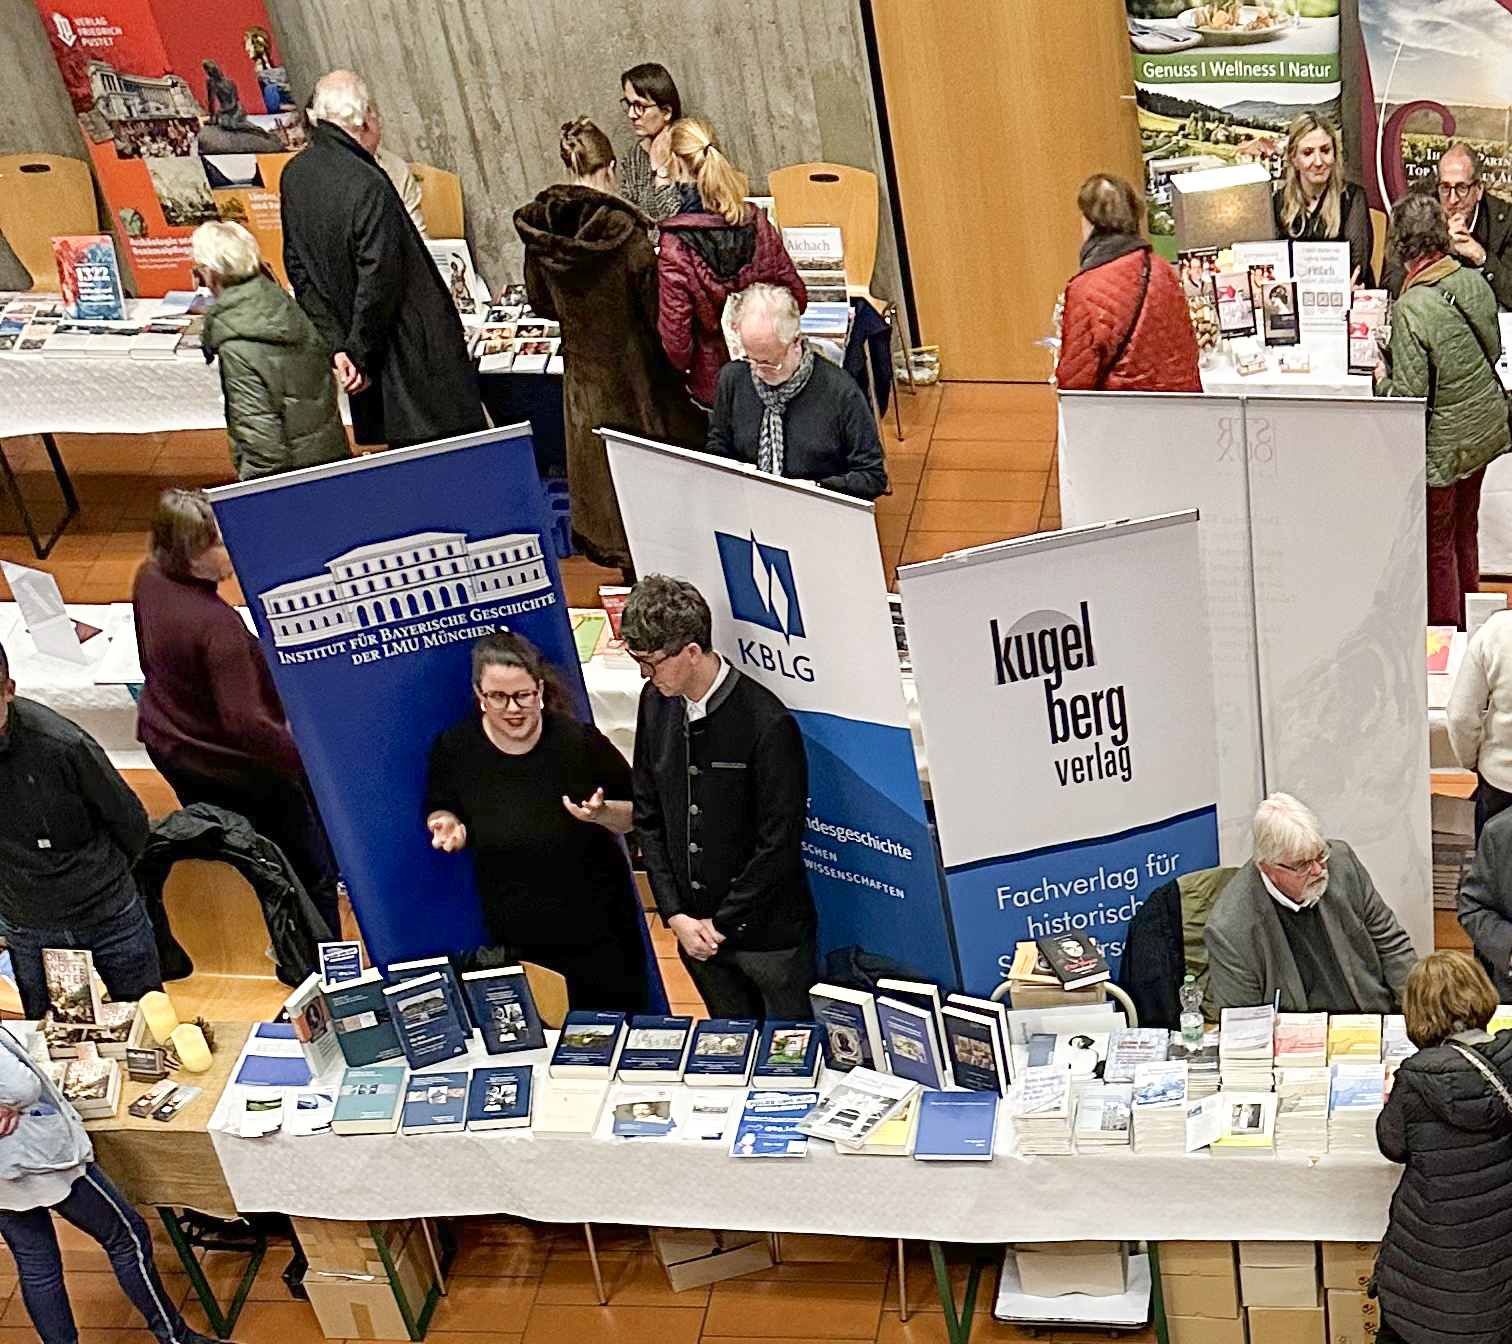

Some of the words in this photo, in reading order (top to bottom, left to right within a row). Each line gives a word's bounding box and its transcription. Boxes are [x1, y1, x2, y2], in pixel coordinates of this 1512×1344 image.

[1143, 61, 1198, 78] Genuss
[1209, 61, 1276, 78] Wellness
[1288, 61, 1331, 78] Natur
[75, 266, 111, 282] 1322
[384, 637, 420, 658] LMU
[737, 637, 815, 683] KBLG
[990, 601, 1095, 690] kugel
[1044, 678, 1129, 747] berg
[1055, 742, 1132, 787] verlag
[801, 841, 838, 862] SCHEN
[805, 816, 913, 861] ndesgeschichte
[996, 861, 1139, 910] Fachverlag
[1145, 851, 1181, 878] für
[1027, 897, 1144, 939] historisch
